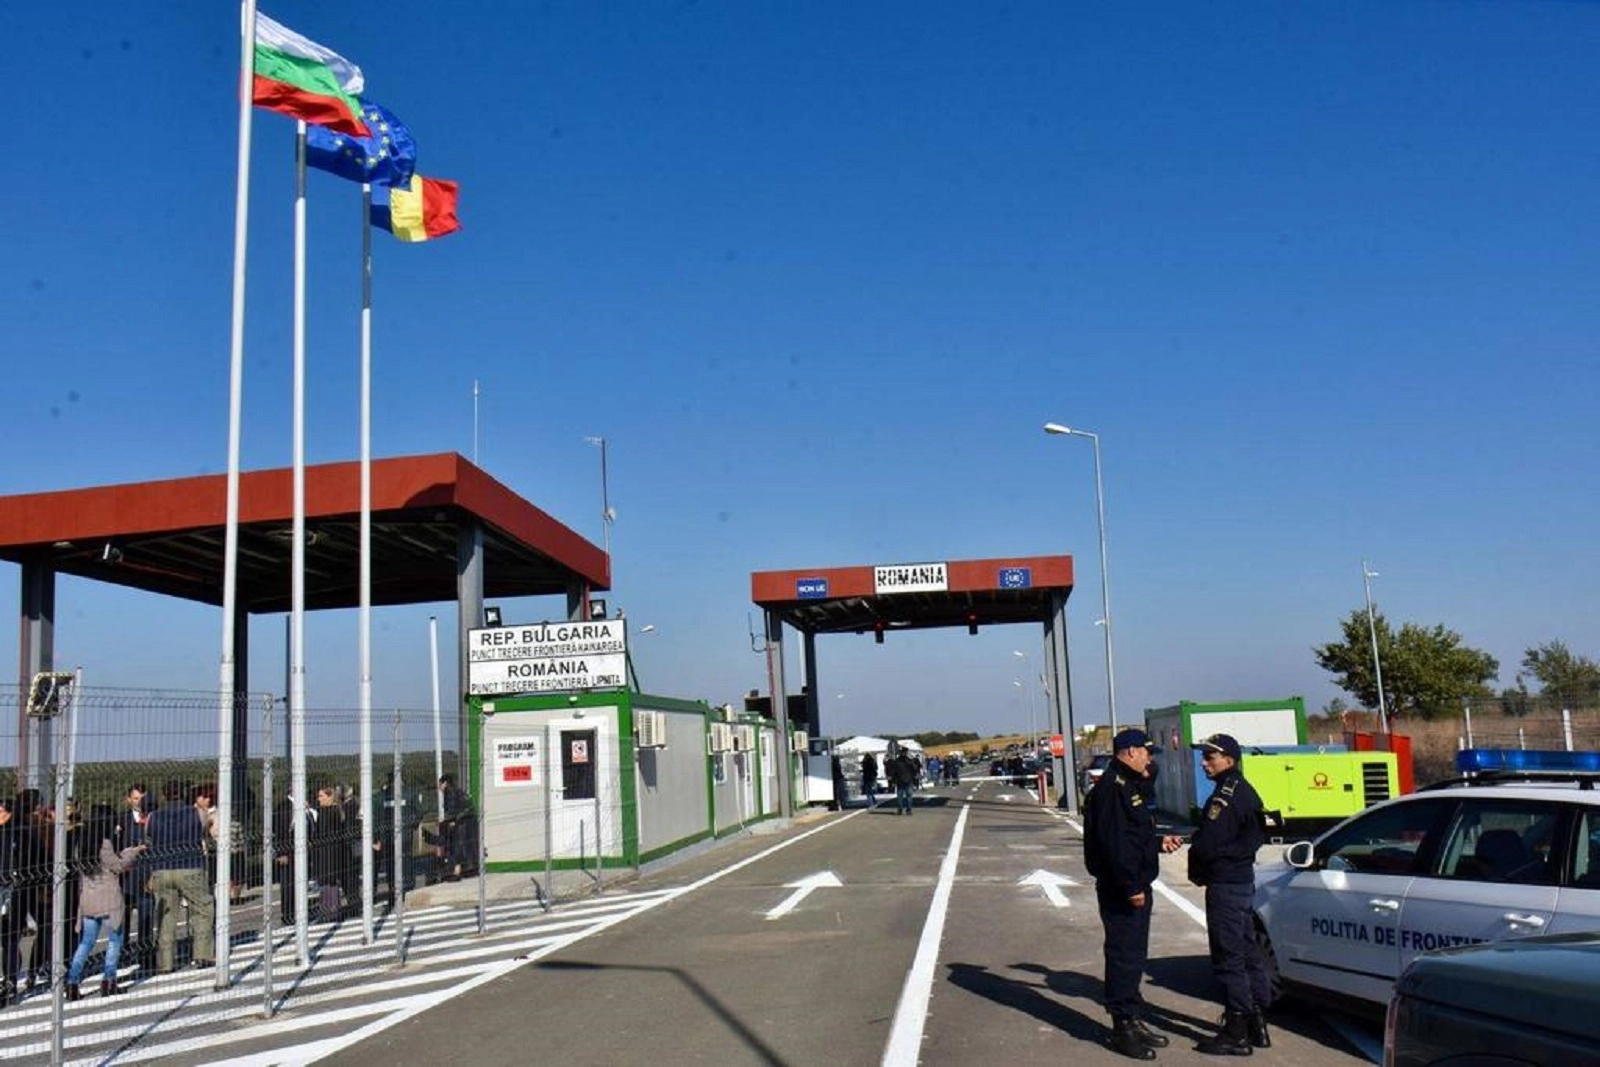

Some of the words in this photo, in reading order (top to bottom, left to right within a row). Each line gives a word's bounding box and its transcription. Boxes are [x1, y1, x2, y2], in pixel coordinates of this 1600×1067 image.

[877, 566, 944, 587] ROMANIA
[480, 631, 517, 646] REP.
[522, 625, 612, 644] BULGARIA
[471, 647, 496, 660] PUNCT
[507, 659, 589, 678] ROMÂNIA
[471, 682, 499, 694] PUNCT
[1311, 917, 1369, 943] POLITIA
[1374, 925, 1396, 946] DE
